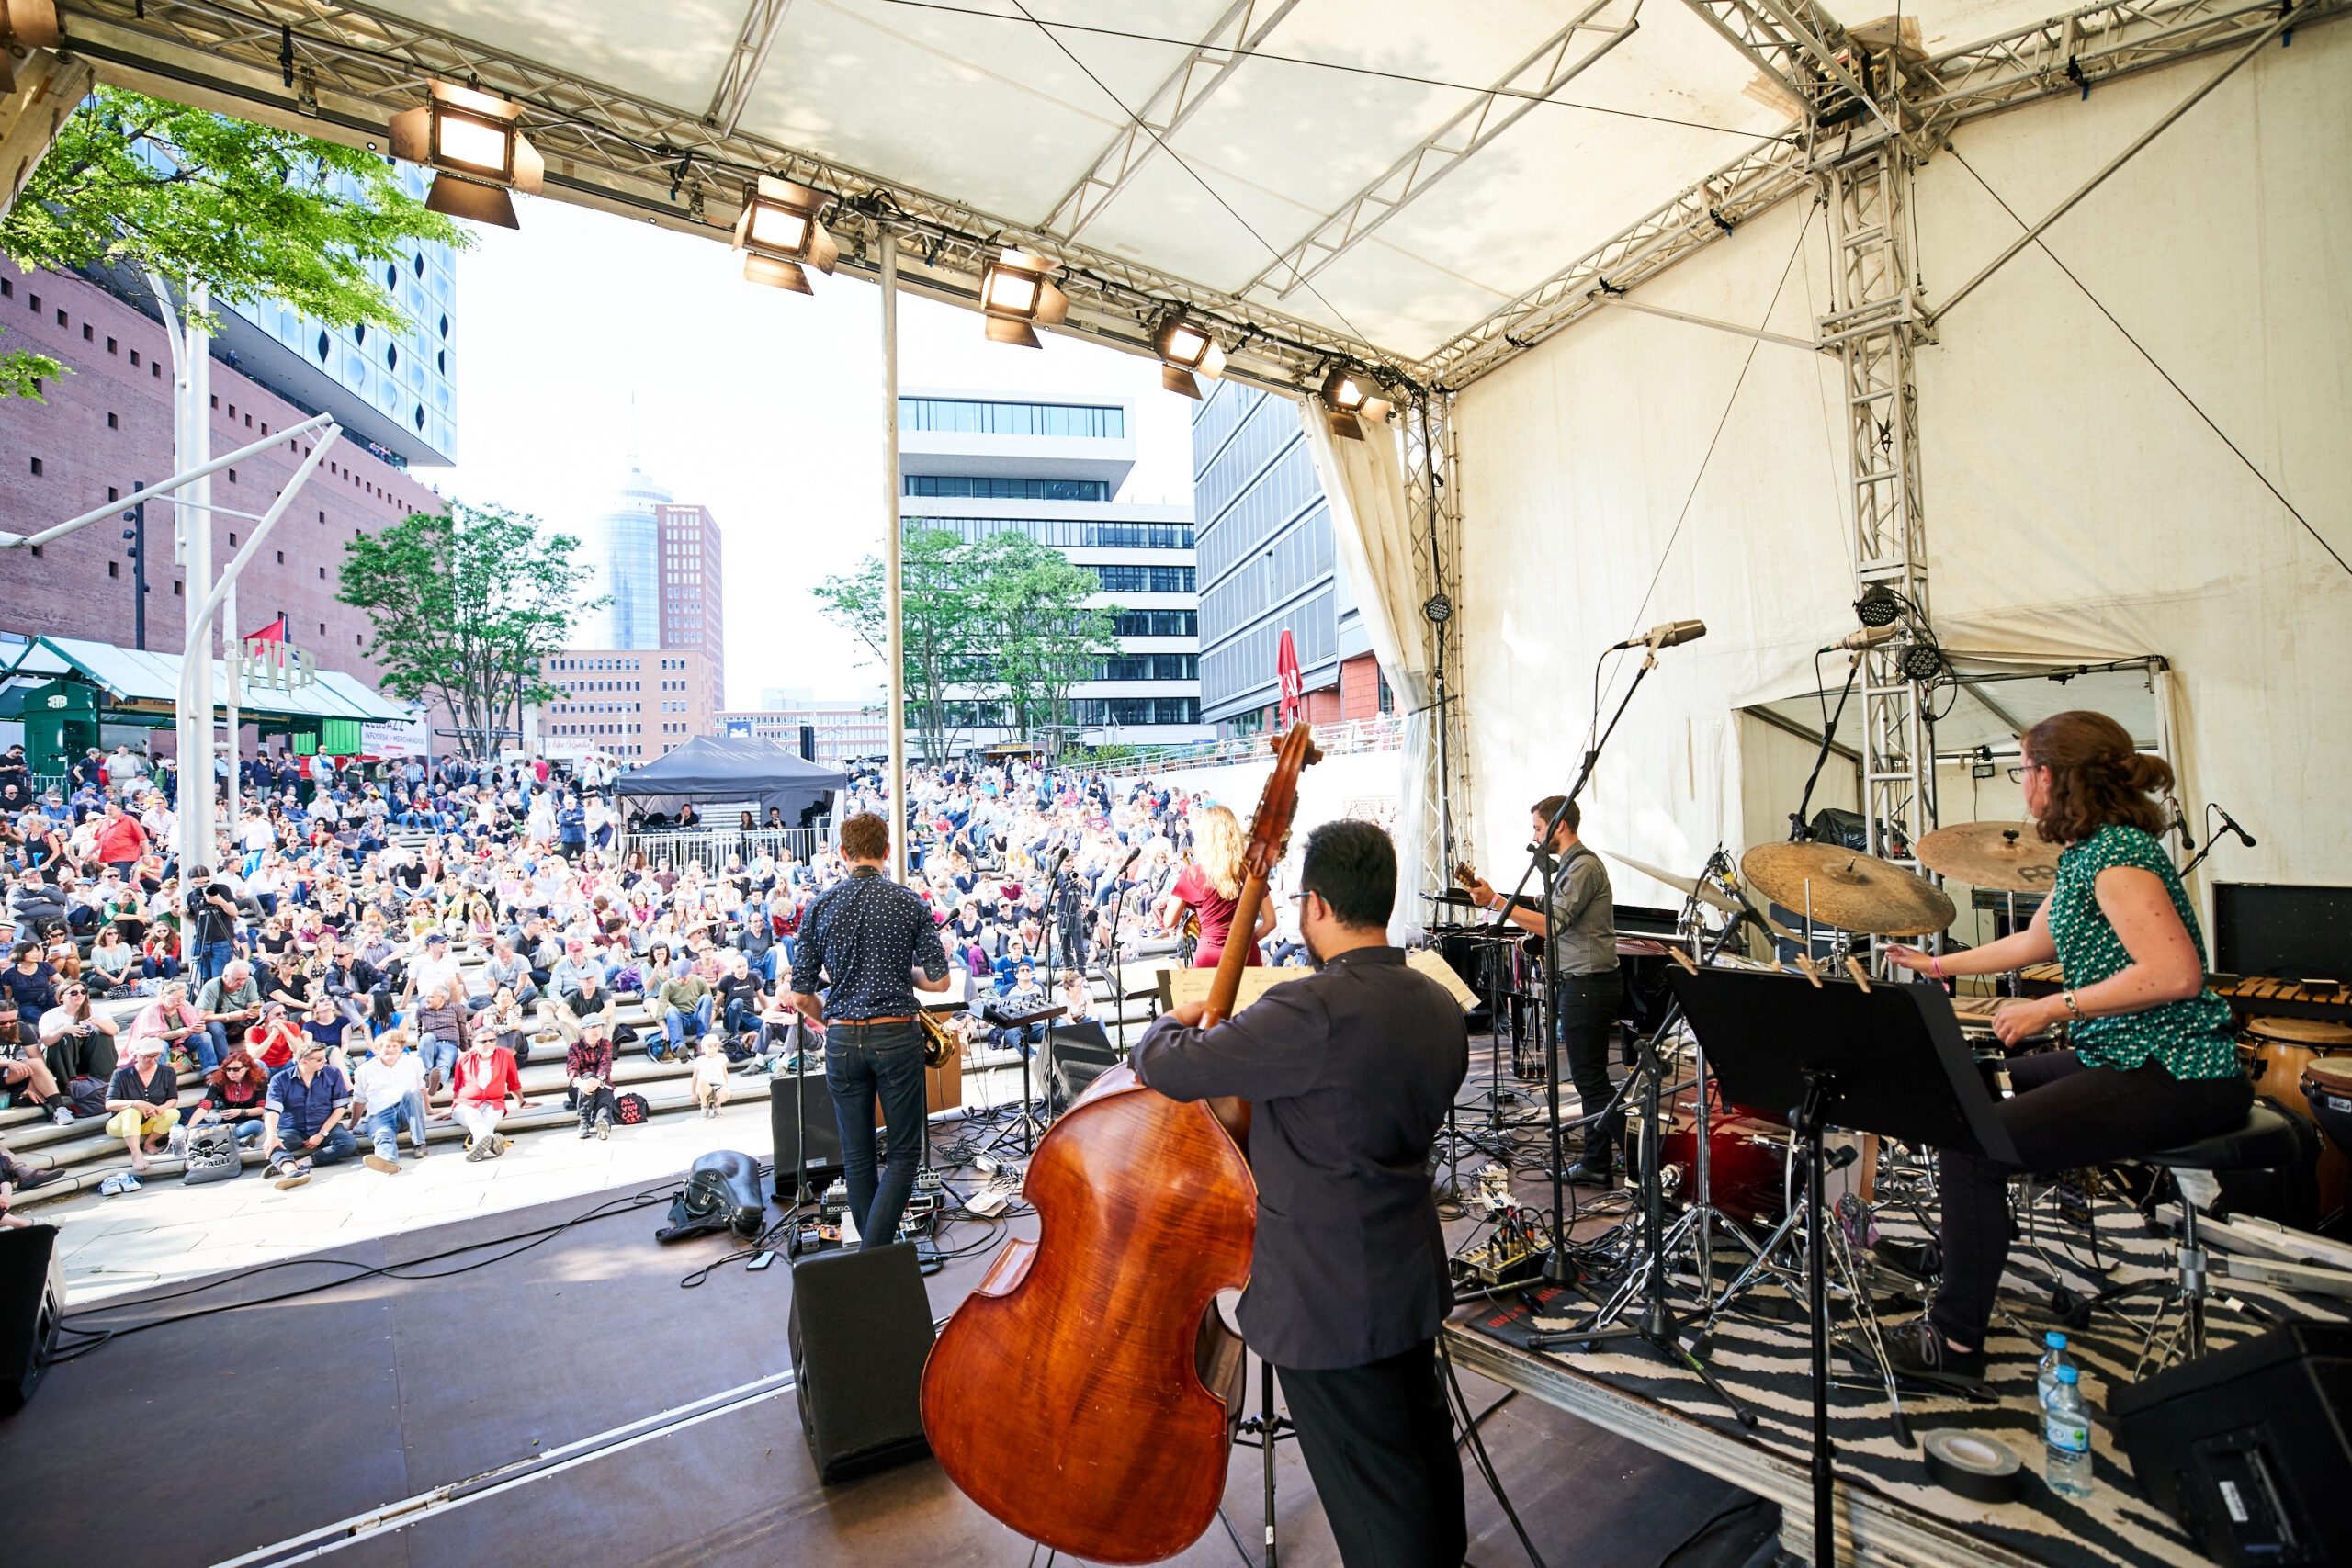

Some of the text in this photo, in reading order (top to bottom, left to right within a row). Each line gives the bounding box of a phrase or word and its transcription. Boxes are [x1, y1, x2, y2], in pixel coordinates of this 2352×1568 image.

[620, 1098, 636, 1107] ALL
[620, 1103, 639, 1113] YOU
[621, 1111, 638, 1120] CAN
[626, 1114, 642, 1124] ART
[203, 1158, 230, 1168] AULI
